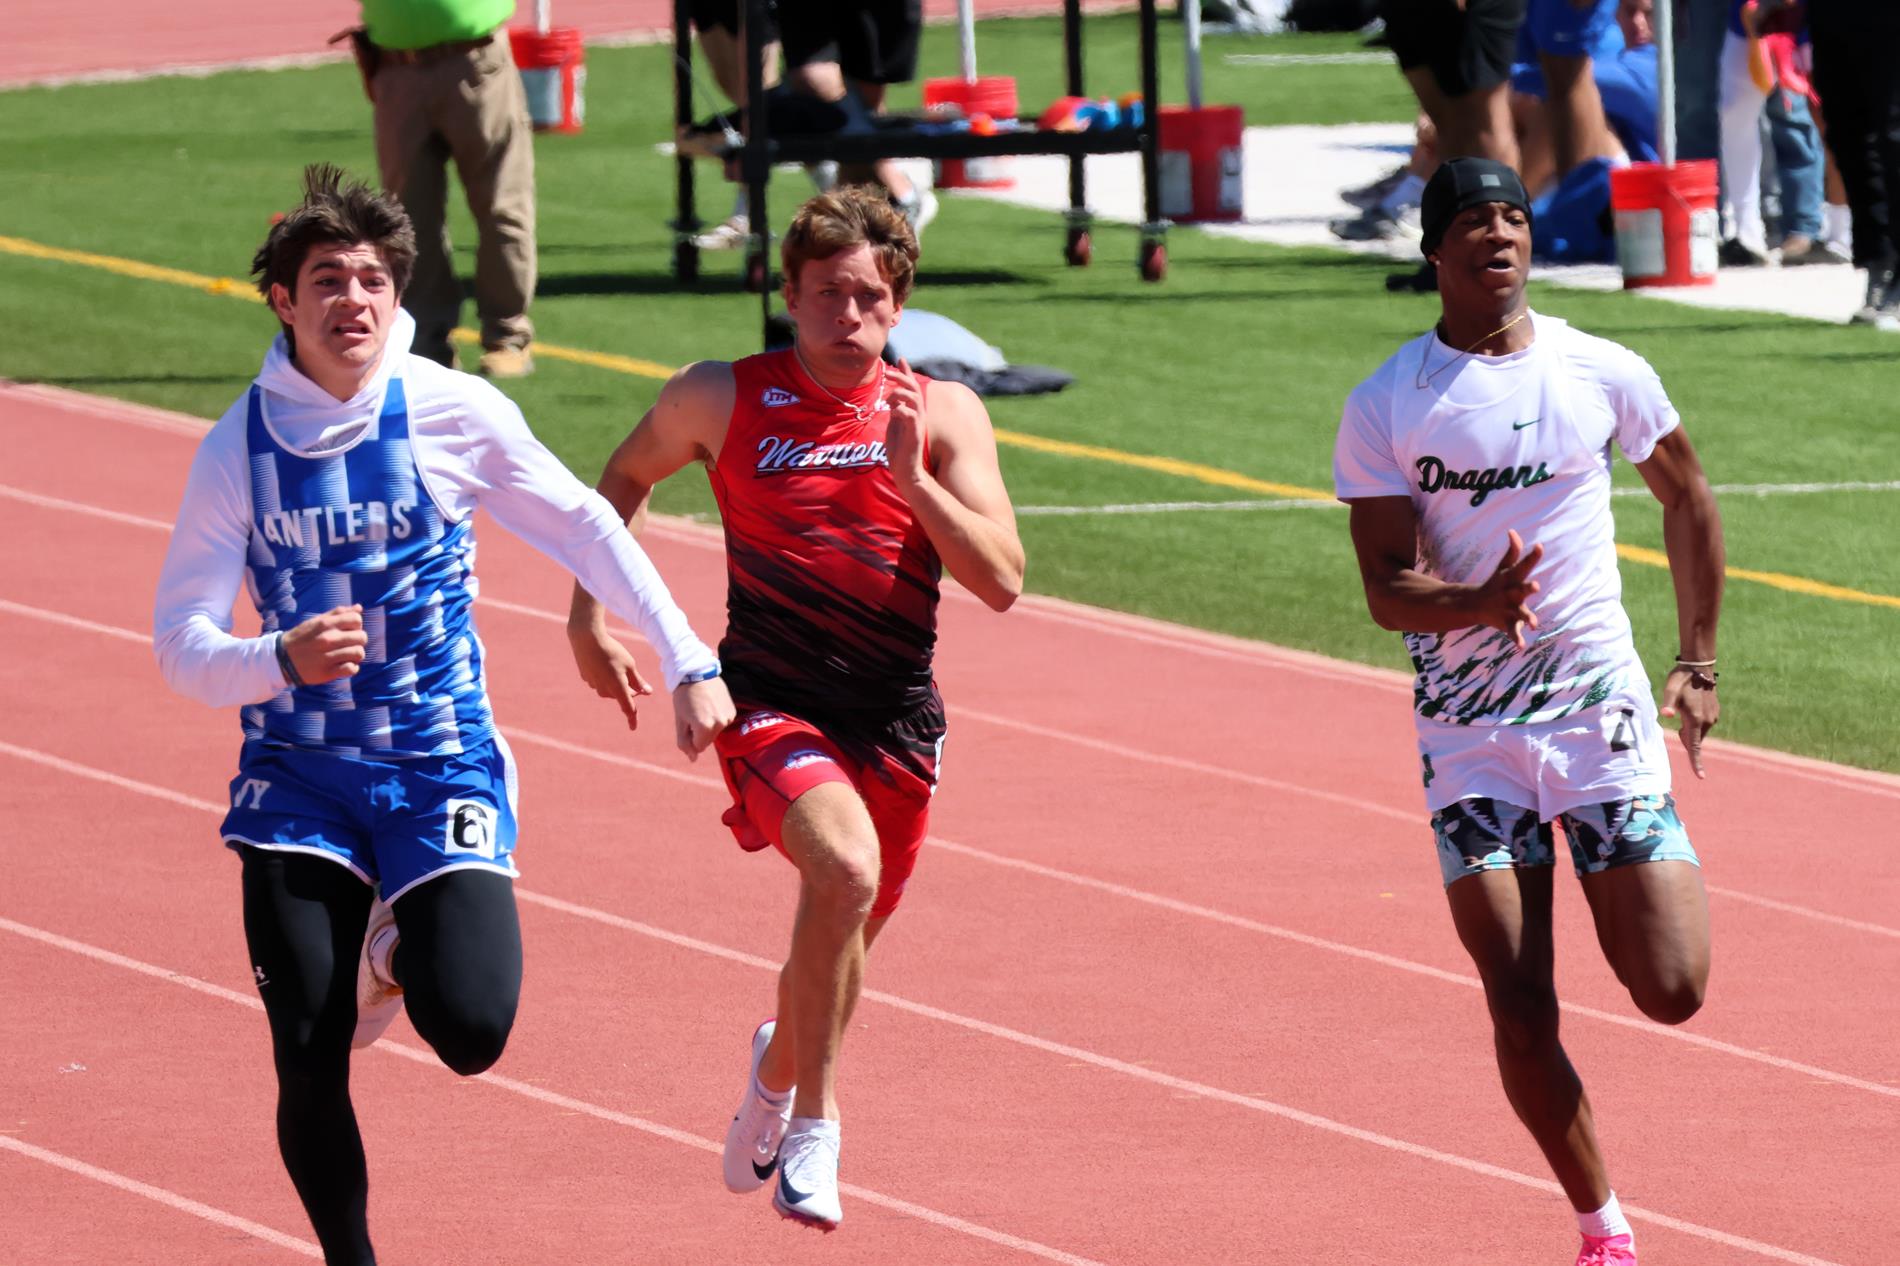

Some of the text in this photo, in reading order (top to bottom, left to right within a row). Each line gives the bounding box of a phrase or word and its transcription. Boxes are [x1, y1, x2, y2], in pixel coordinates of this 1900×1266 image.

[1416, 456, 1555, 507] Dragons
[263, 501, 413, 547] ANTLERS
[453, 803, 488, 848] 6
